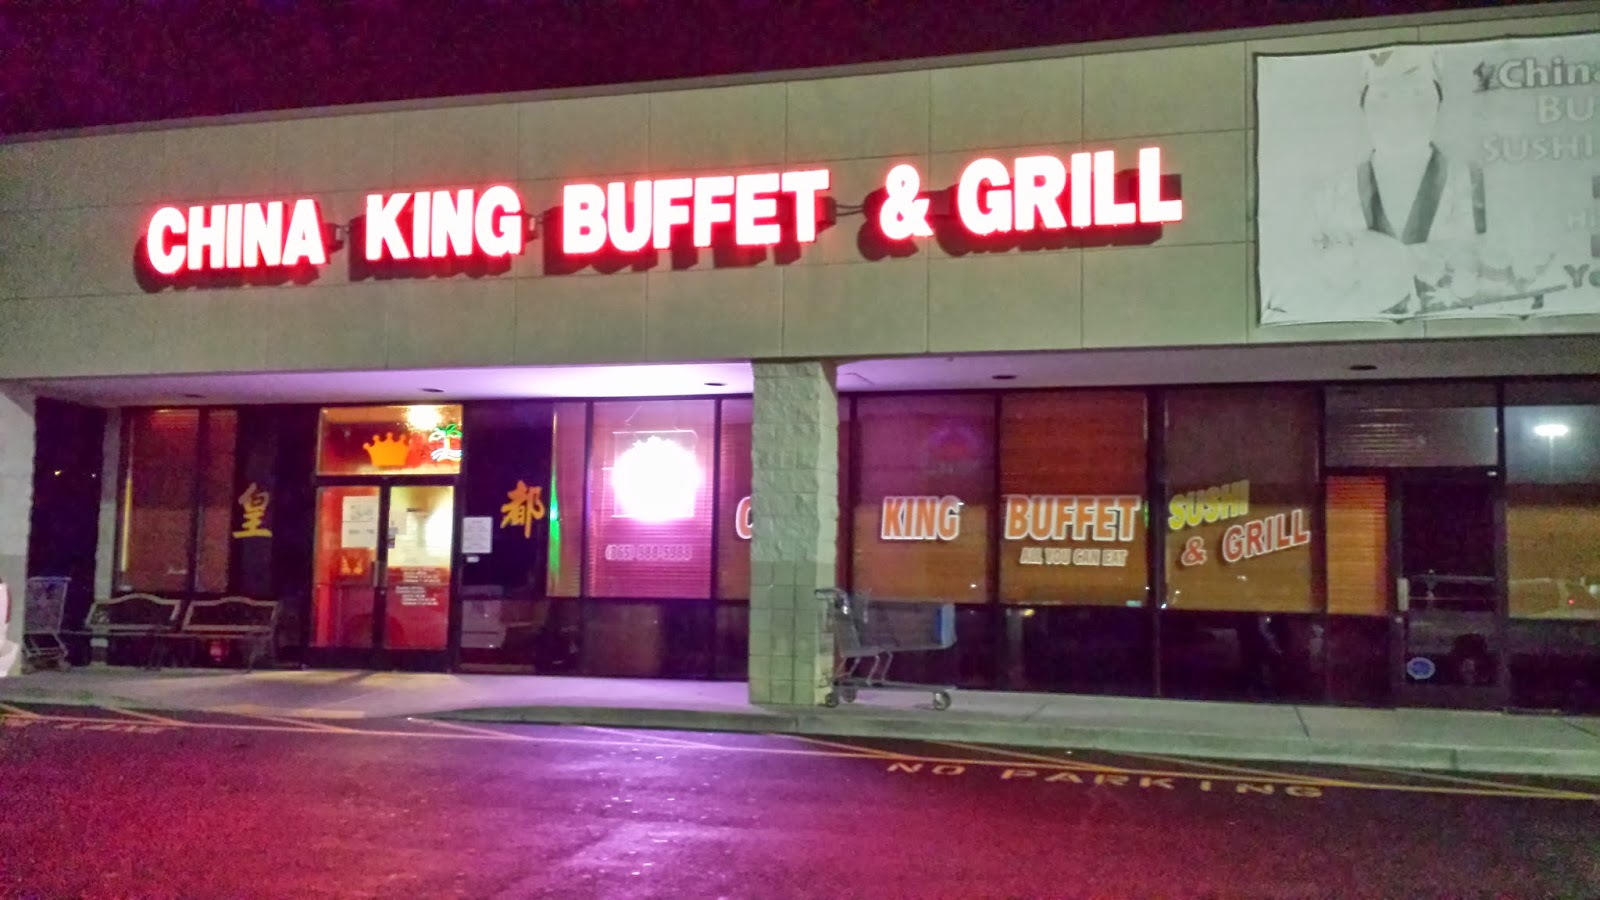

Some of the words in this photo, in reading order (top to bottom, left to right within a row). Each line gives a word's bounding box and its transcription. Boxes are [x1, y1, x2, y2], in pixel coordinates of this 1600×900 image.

[1482, 133, 1592, 163] SUSHI
[147, 199, 326, 275] CHINA
[365, 185, 523, 261] KING
[562, 169, 831, 255] BUFFET
[879, 164, 934, 240] &
[957, 146, 1184, 236] GRILL
[232, 482, 273, 539] 皇
[500, 480, 545, 539] 都
[880, 496, 961, 540] KING
[1003, 494, 1142, 541] BUFFET
[1168, 480, 1250, 530] SUSHI
[1044, 547, 1072, 566] YOU
[1072, 548, 1101, 567] CAN
[1101, 549, 1129, 567] EAT
[1181, 536, 1207, 566] &
[1222, 509, 1311, 562] GRILL
[886, 761, 968, 777] NO
[1000, 768, 1324, 799] PARKING
